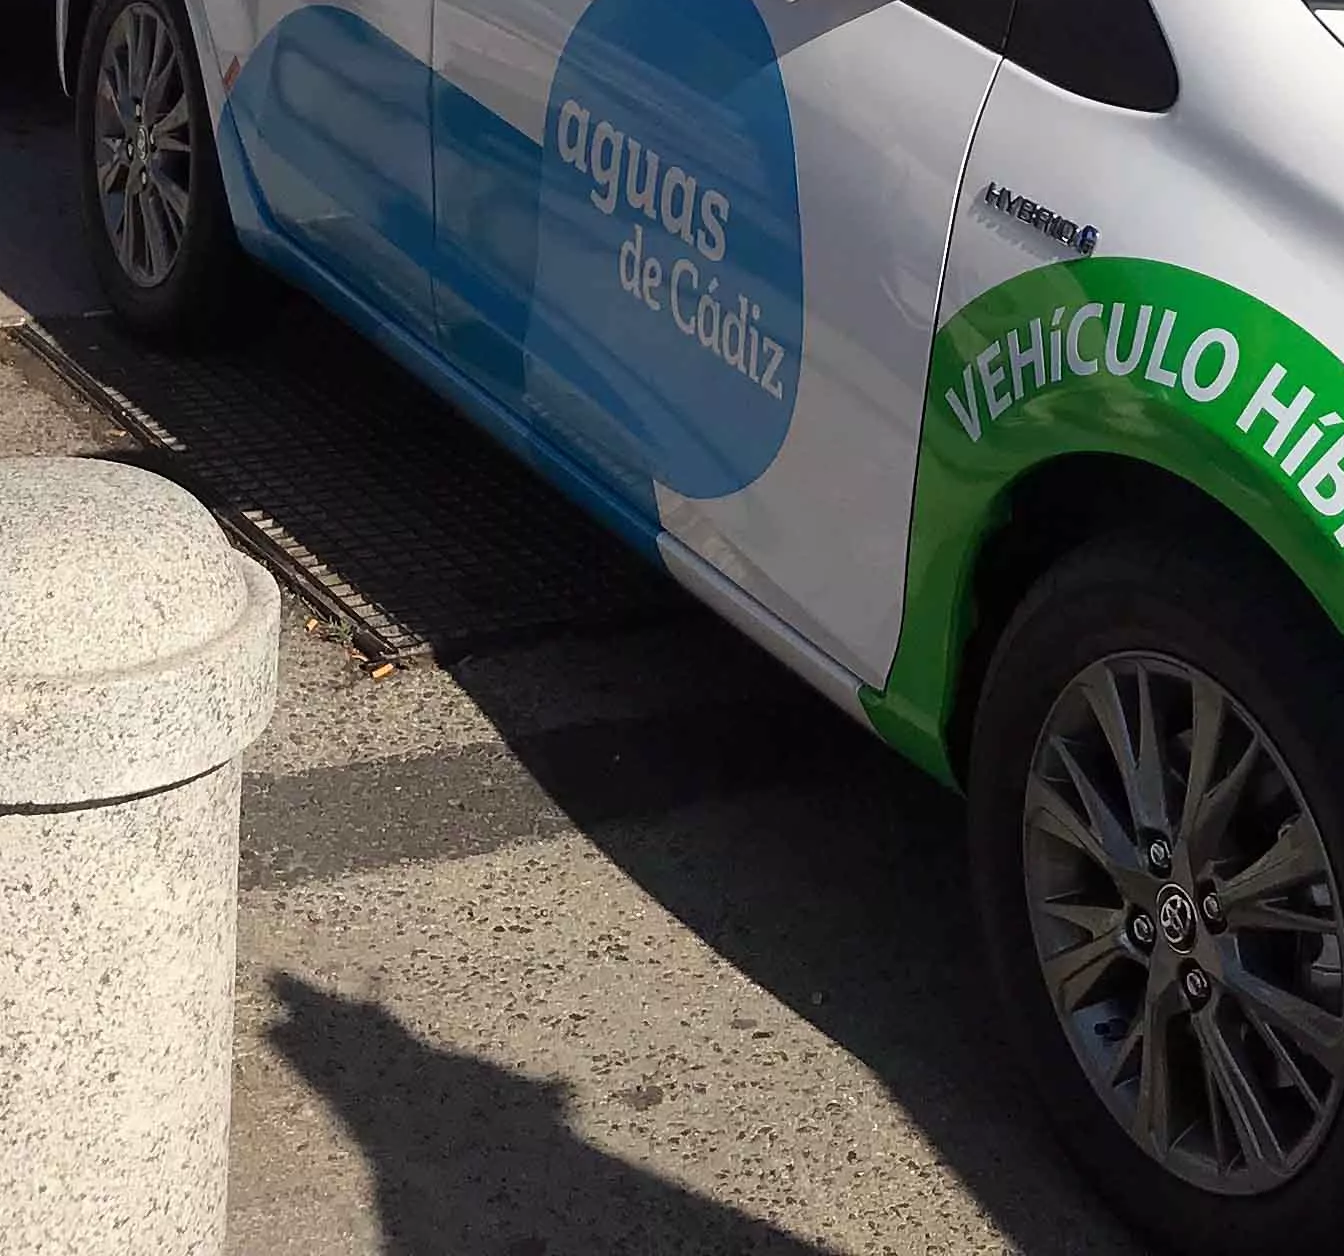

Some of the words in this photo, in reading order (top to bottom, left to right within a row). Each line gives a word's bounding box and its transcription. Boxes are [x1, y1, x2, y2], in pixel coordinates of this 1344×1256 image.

[557, 99, 730, 262] aguas
[984, 181, 1080, 247] HYBRID
[619, 223, 663, 311] de
[670, 258, 785, 400] Cádiz
